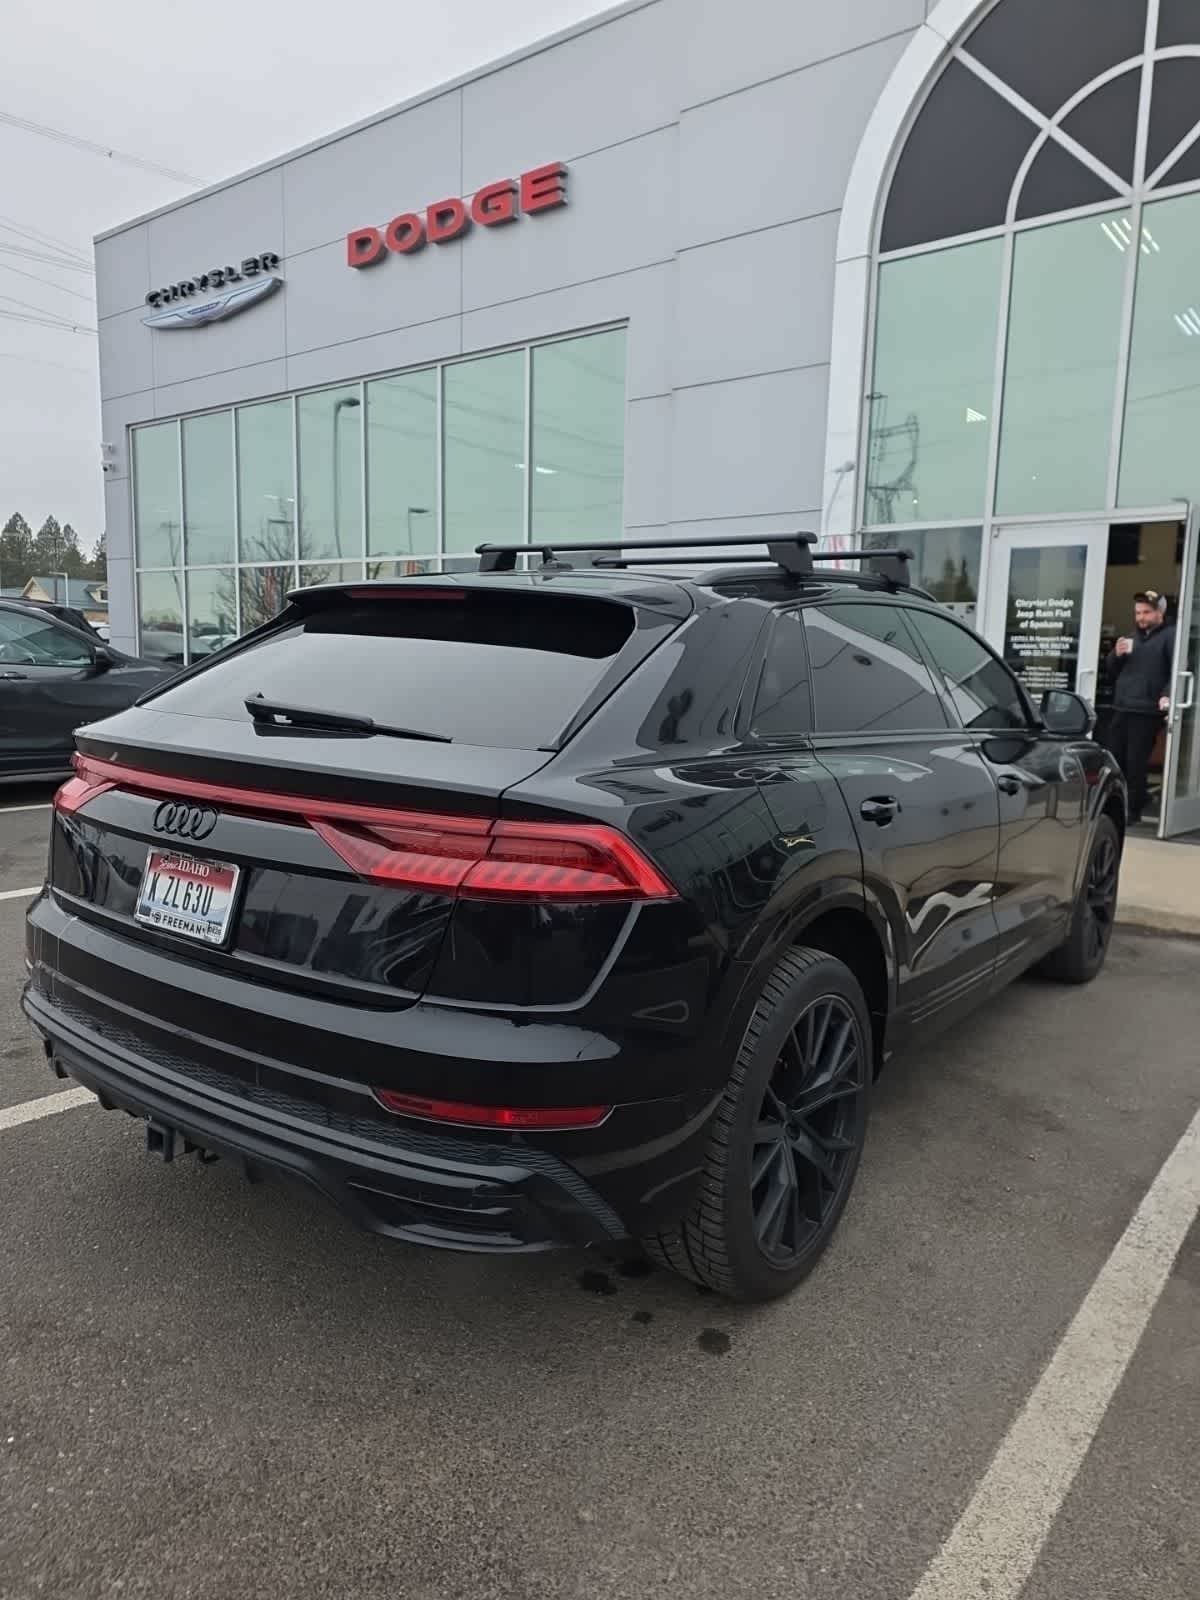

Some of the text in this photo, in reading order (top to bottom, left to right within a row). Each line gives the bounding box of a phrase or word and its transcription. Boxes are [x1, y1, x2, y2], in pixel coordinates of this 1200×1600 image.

[347, 161, 568, 269] DODGE
[145, 252, 280, 308] CHRYSLER
[1035, 609, 1054, 618] Ram
[1048, 598, 1074, 608] Dodge
[178, 859, 210, 877] IDAHO
[162, 875, 214, 917] ZL63U
[163, 915, 202, 936] FREEMAN
